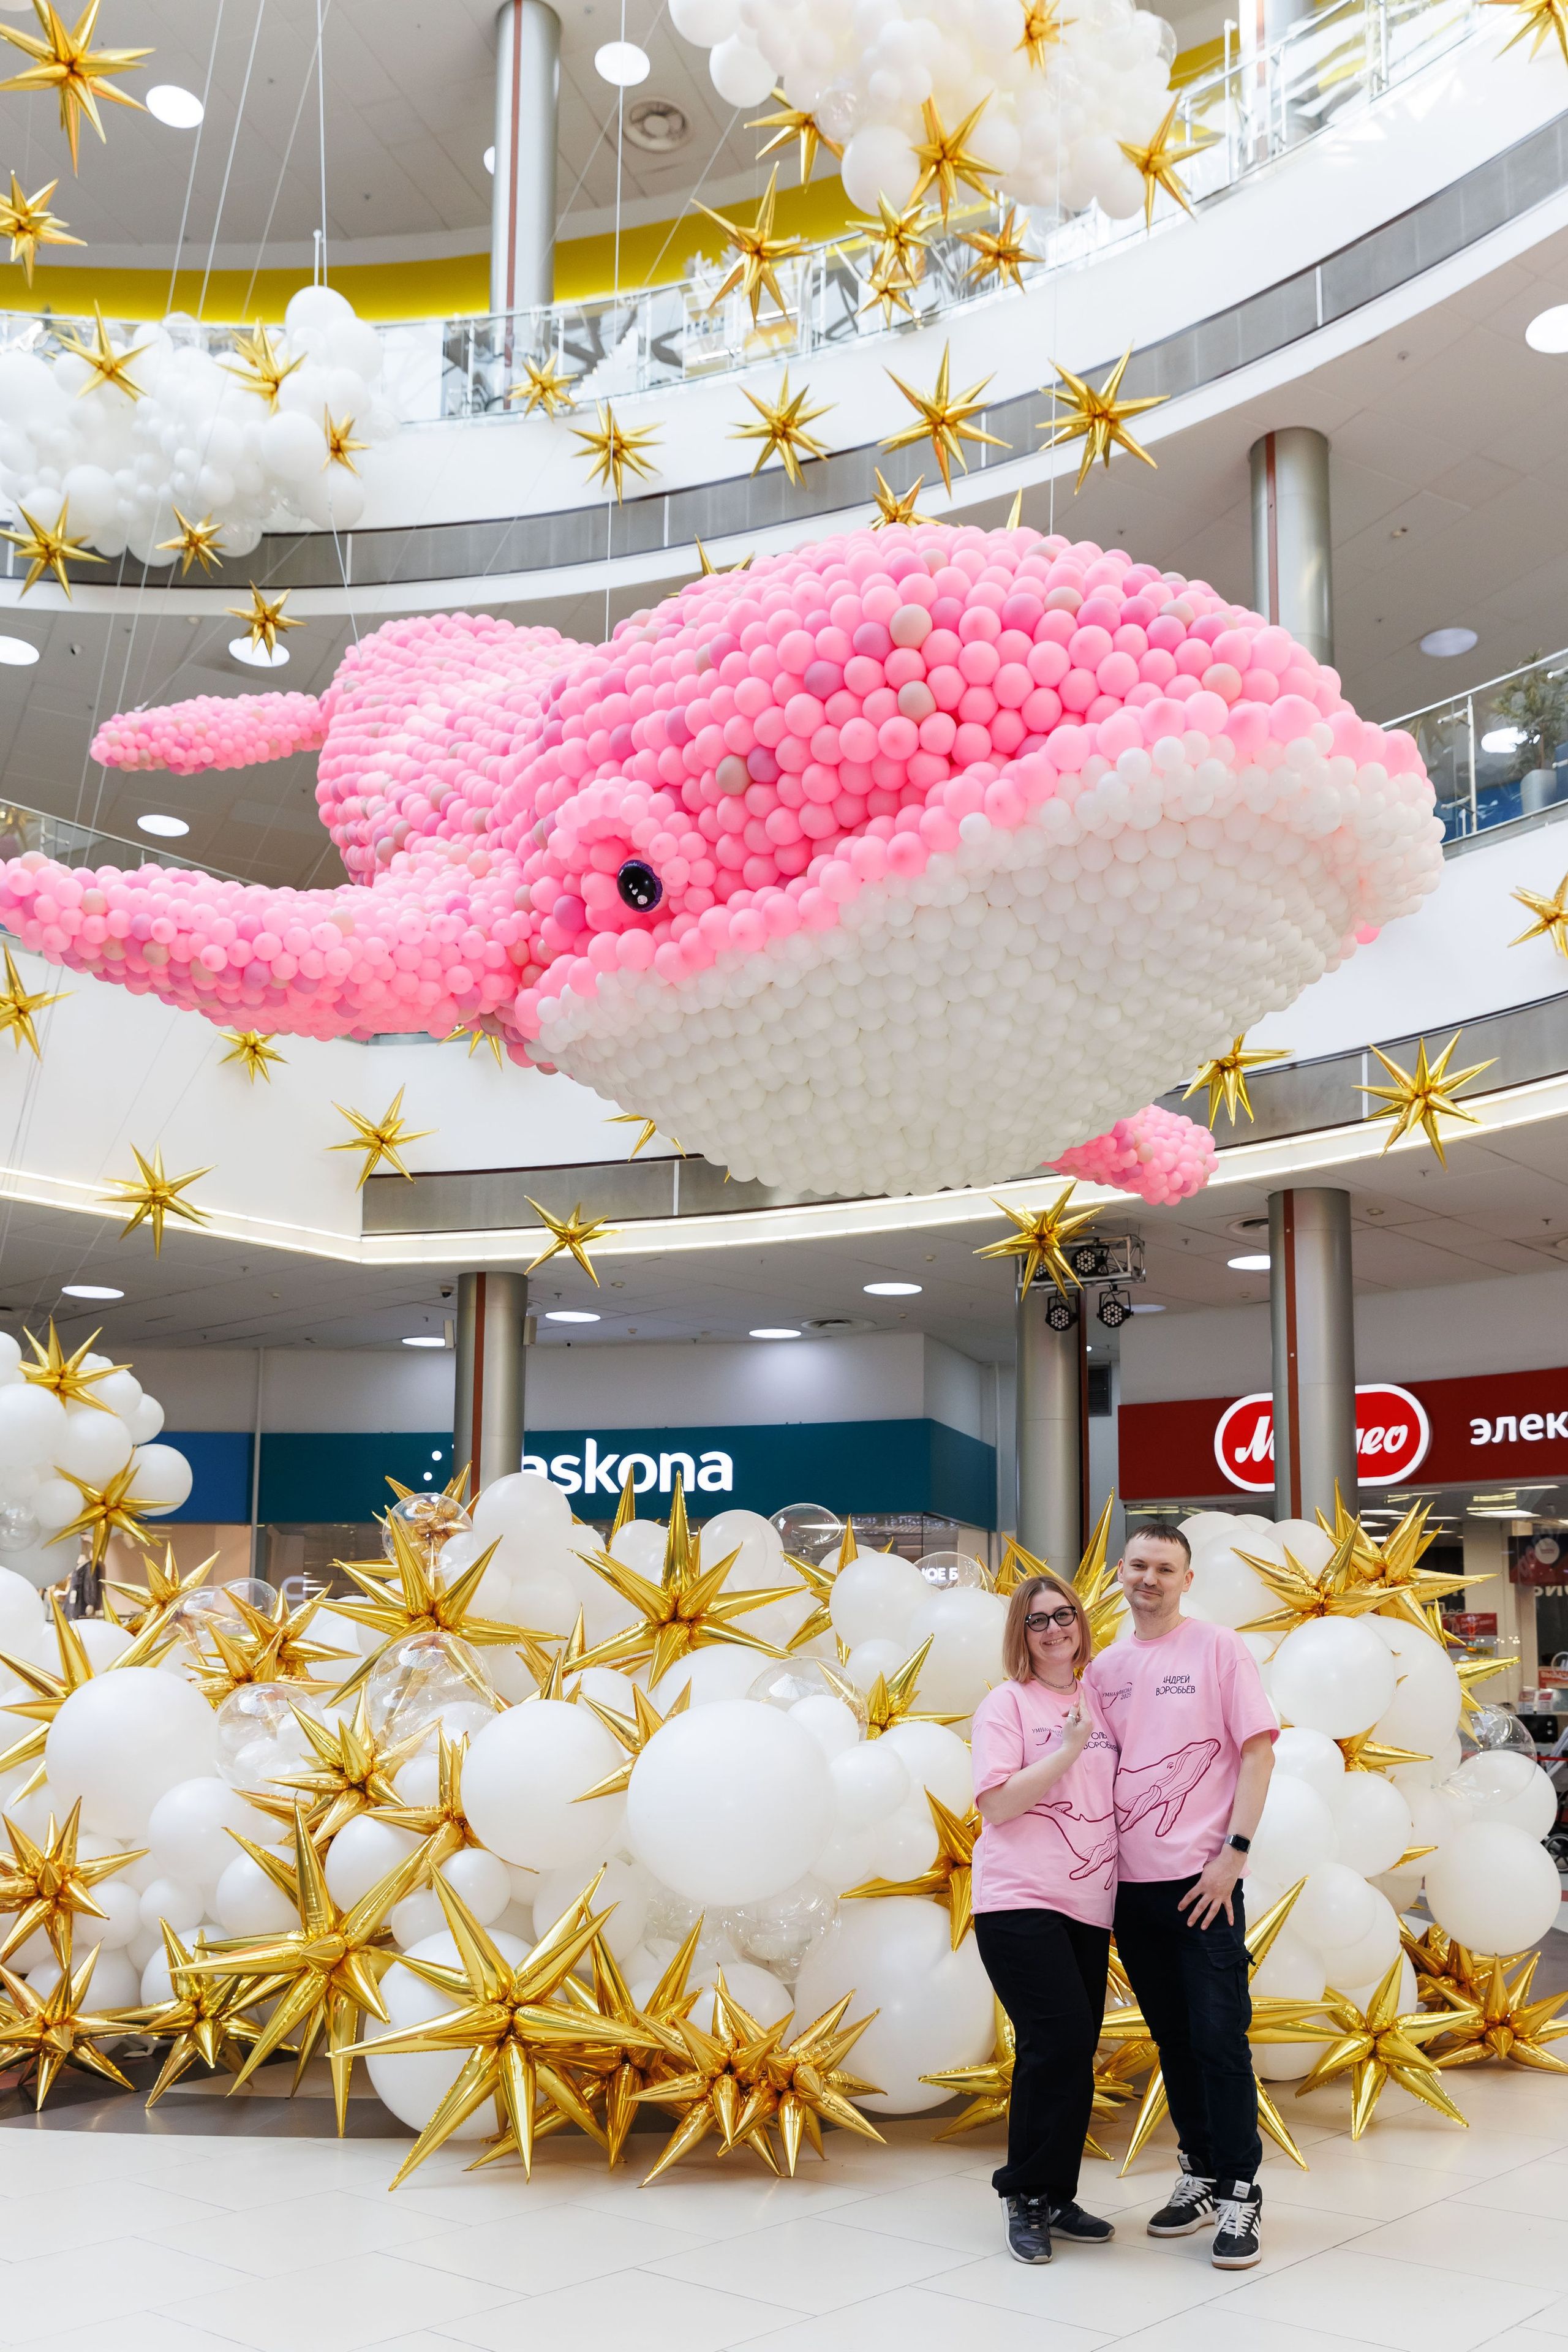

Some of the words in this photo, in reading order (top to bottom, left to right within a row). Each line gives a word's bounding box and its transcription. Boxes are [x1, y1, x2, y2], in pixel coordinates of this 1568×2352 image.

[1163, 1675, 1190, 1684] АНДРЕЙ
[1156, 1685, 1196, 1696] ВОРОБЬЁВ
[1120, 1692, 1131, 1700] 2025
